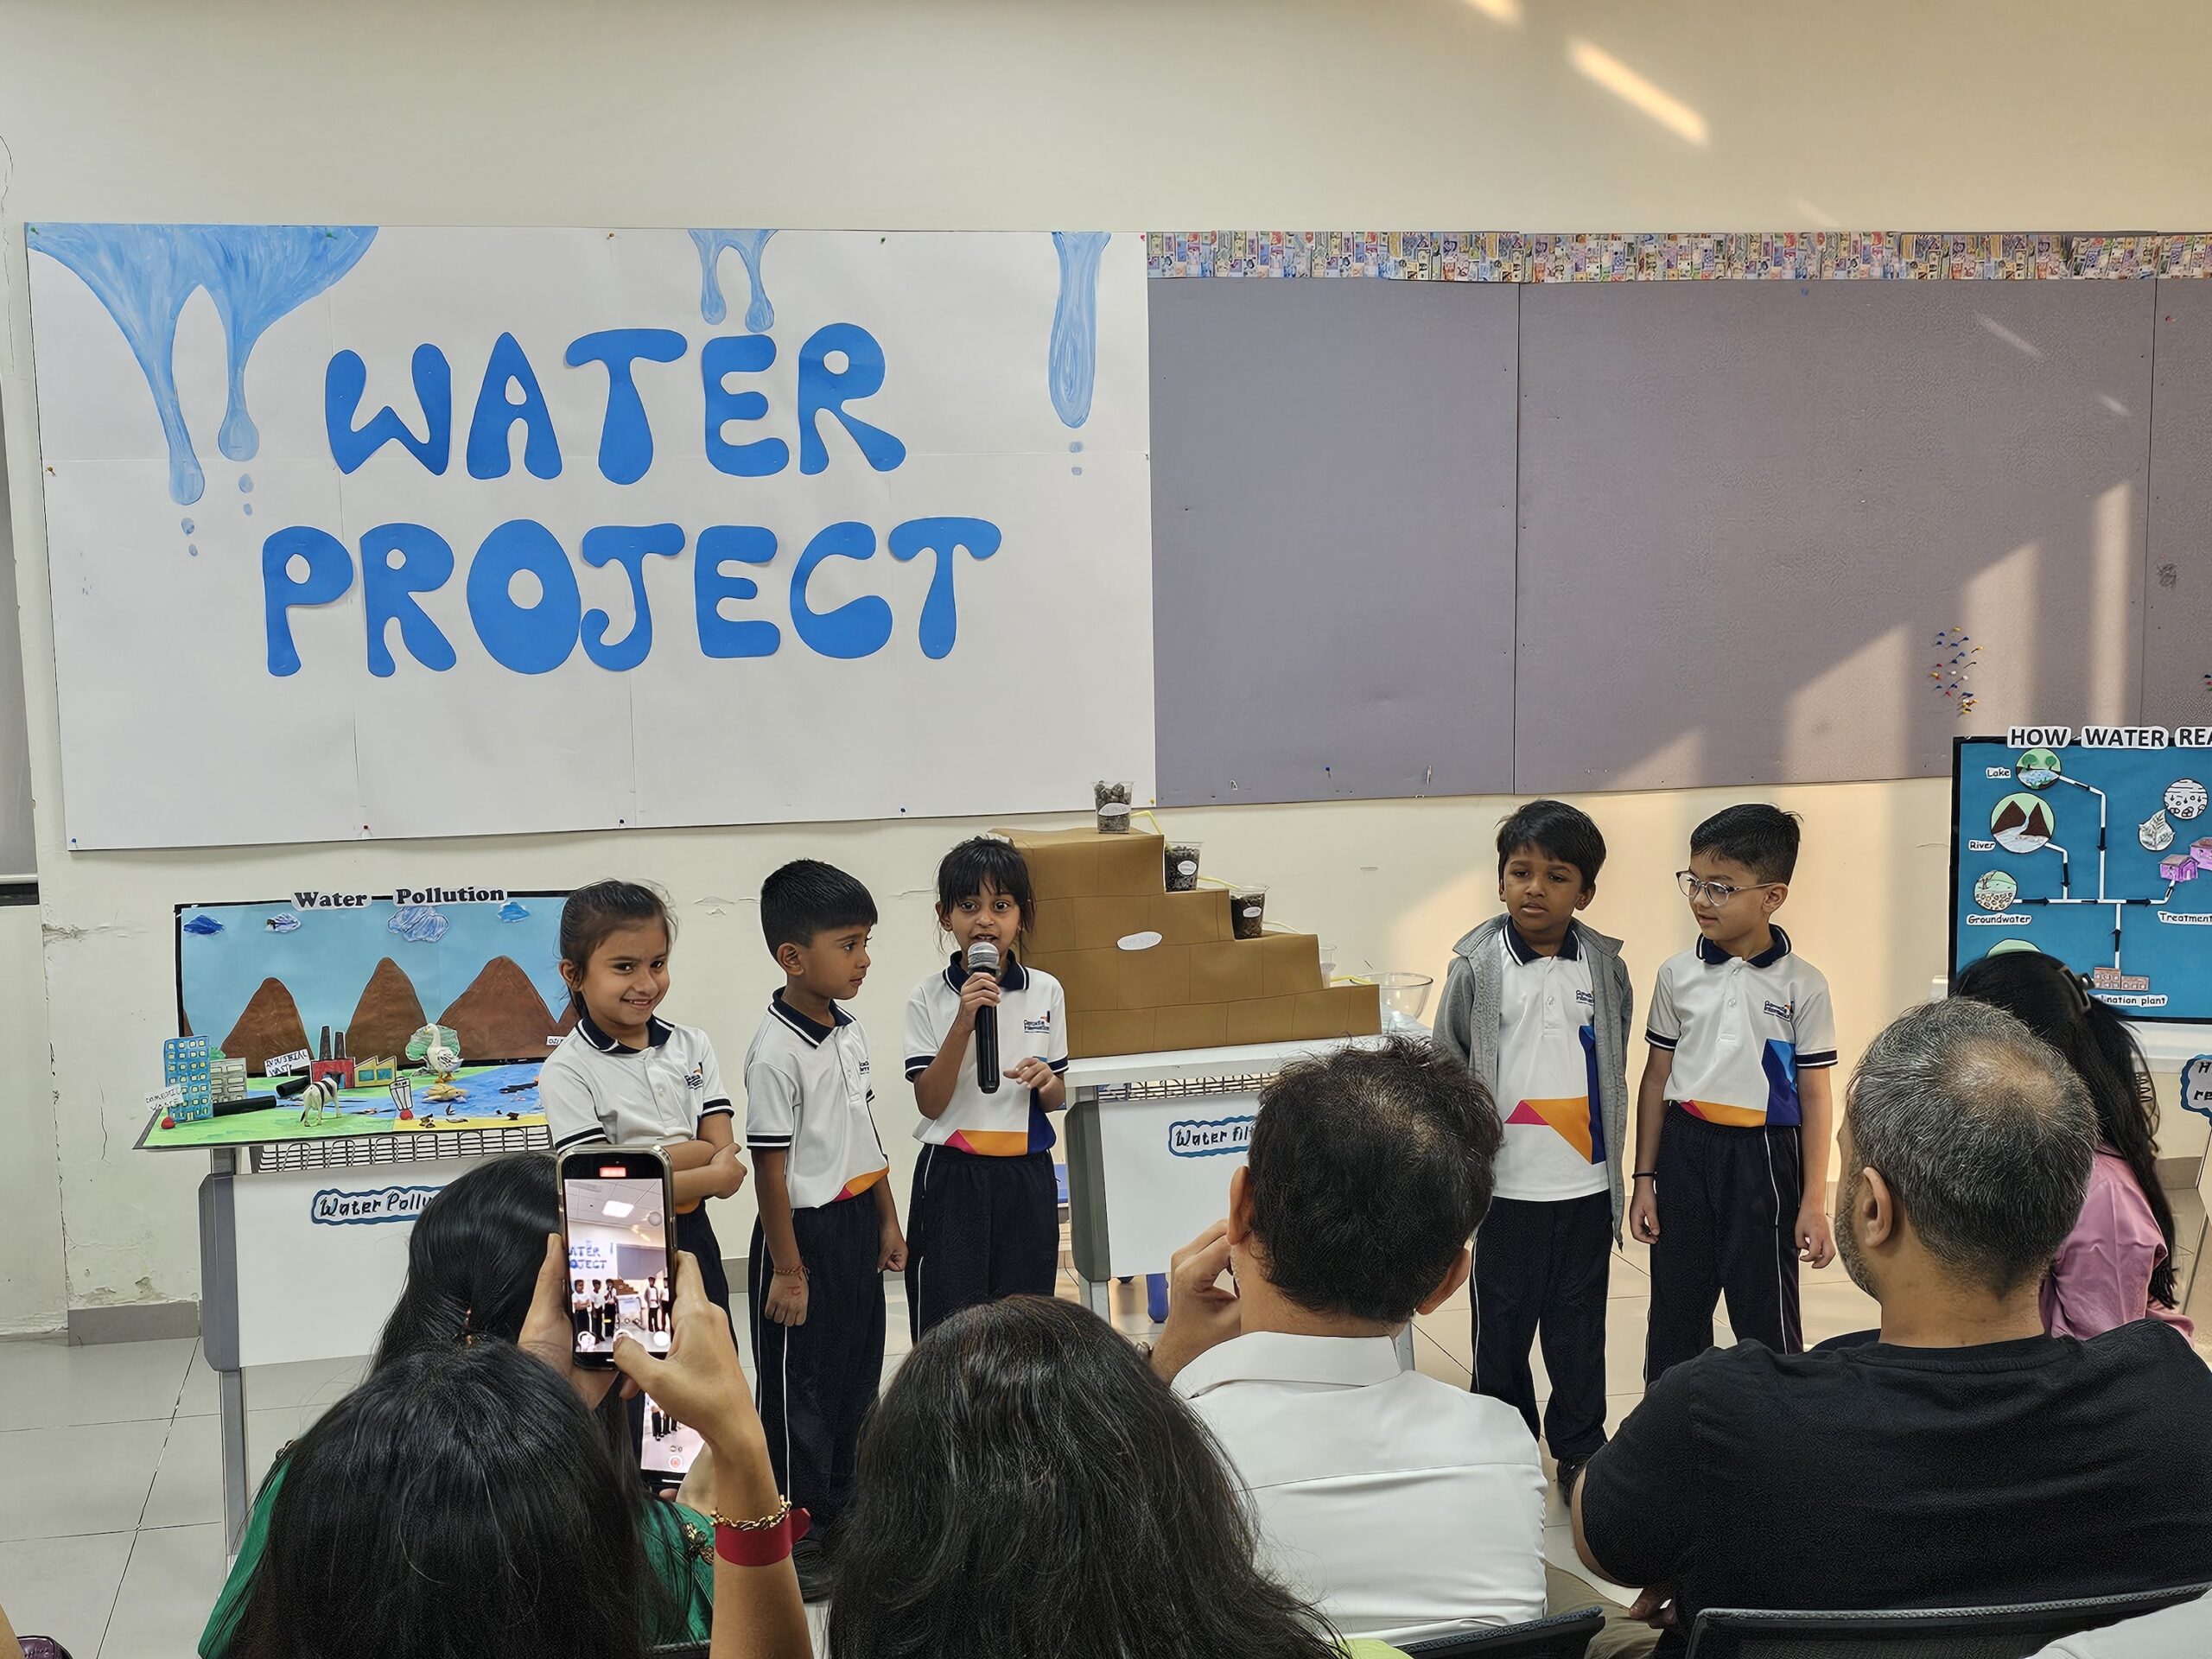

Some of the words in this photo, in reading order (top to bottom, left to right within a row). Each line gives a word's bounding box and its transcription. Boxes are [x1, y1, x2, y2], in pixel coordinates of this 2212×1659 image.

[325, 322, 907, 485] WATER
[262, 517, 1001, 677] PROJECT
[2011, 728, 2067, 746] HOW
[2085, 728, 2164, 747] WATER
[1987, 768, 2010, 777] Lake
[294, 891, 367, 907] Water
[396, 887, 505, 905] Pollution
[2141, 996, 2165, 1006] plant
[1176, 1128, 1227, 1147] Water
[320, 1197, 381, 1217] Water
[387, 1191, 433, 1211] Pollu
[569, 1246, 601, 1257] ATER
[569, 1259, 607, 1269] OJECT
